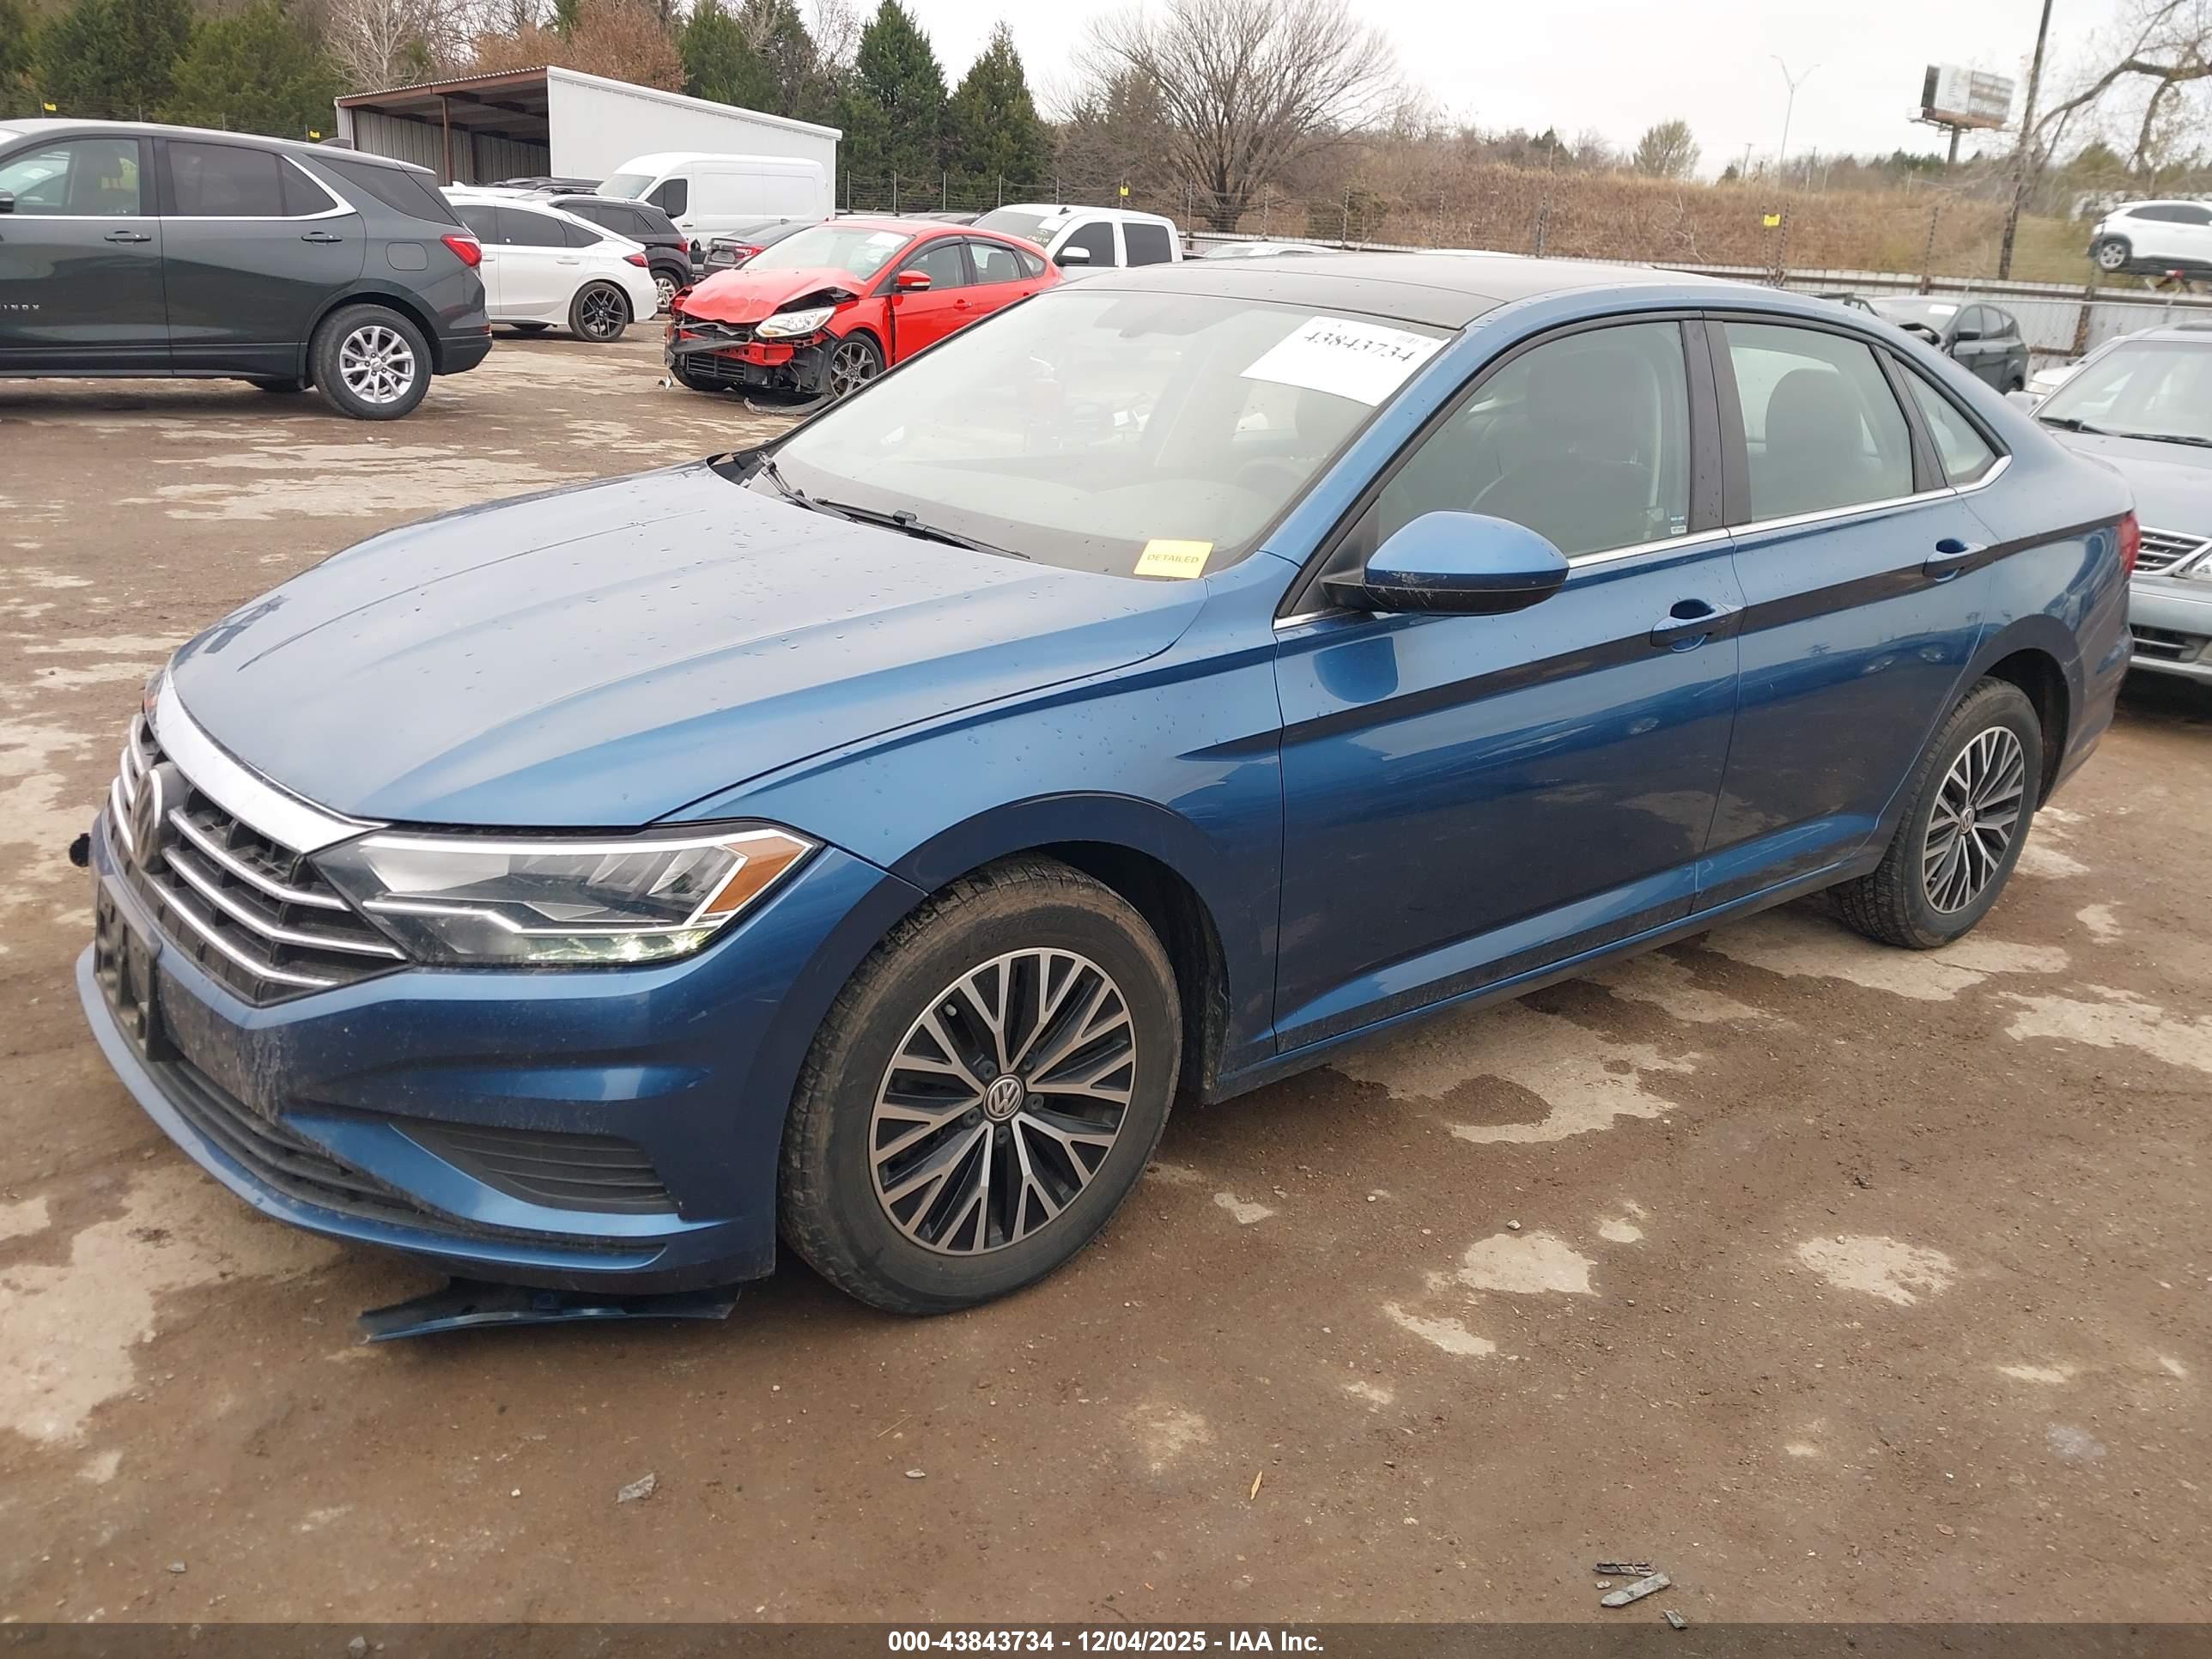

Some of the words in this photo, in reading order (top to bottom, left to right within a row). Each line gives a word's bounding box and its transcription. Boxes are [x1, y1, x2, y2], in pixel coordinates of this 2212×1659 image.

[1304, 331, 1415, 362] 43843734
[1146, 554, 1200, 563] DETAILED
[988, 1079, 1021, 1116] VW
